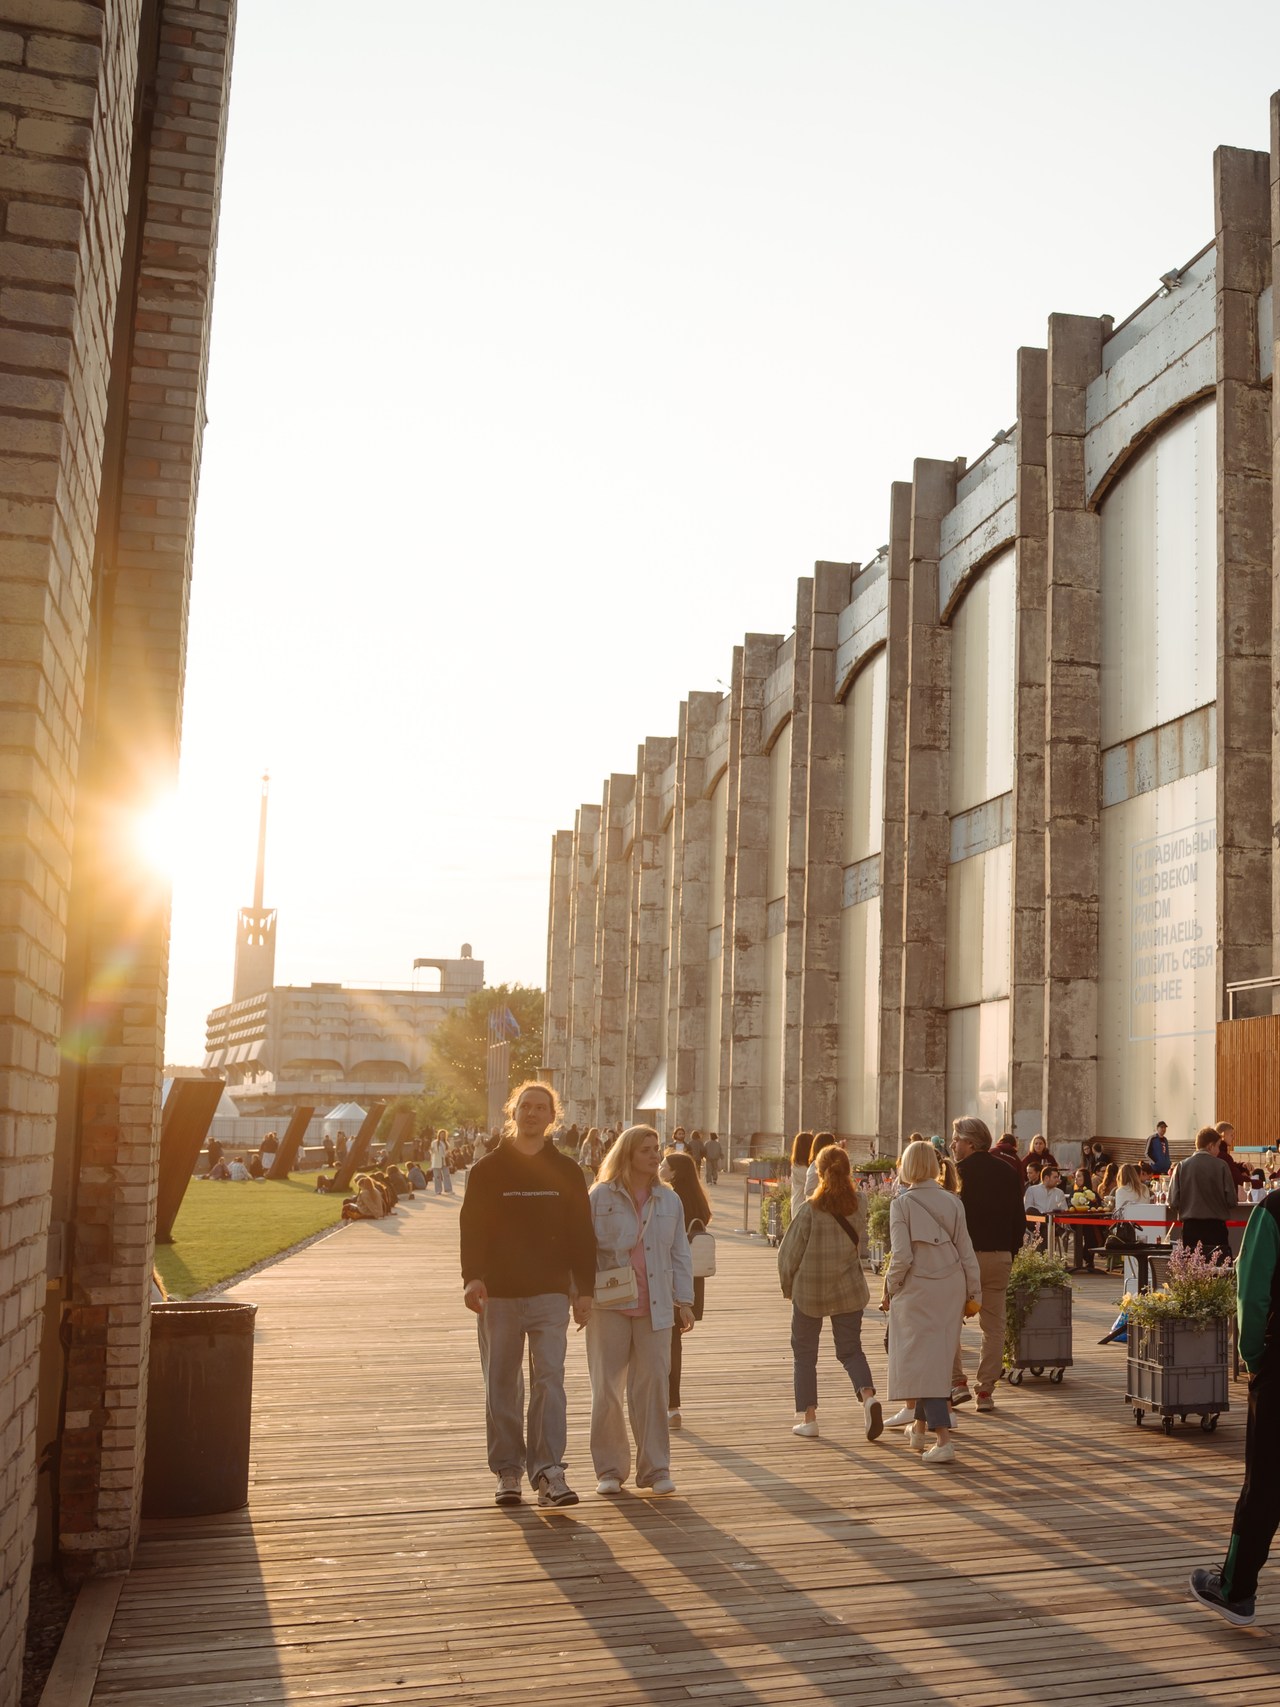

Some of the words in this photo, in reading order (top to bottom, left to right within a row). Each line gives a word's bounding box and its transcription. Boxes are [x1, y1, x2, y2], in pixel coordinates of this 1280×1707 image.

[1145, 828, 1216, 869] ПРАВИЛЬНЫ
[1136, 862, 1198, 897] ЧЕЛОВЕКОМ
[1135, 898, 1171, 925] РЯДОМ
[1135, 919, 1203, 952] НАЧИНАЕШЬ
[1134, 952, 1179, 978] ЛЮБИТЬ
[1182, 945, 1213, 970] СЕБЯ
[1135, 979, 1182, 1004] СИЛЬНЕЕ
